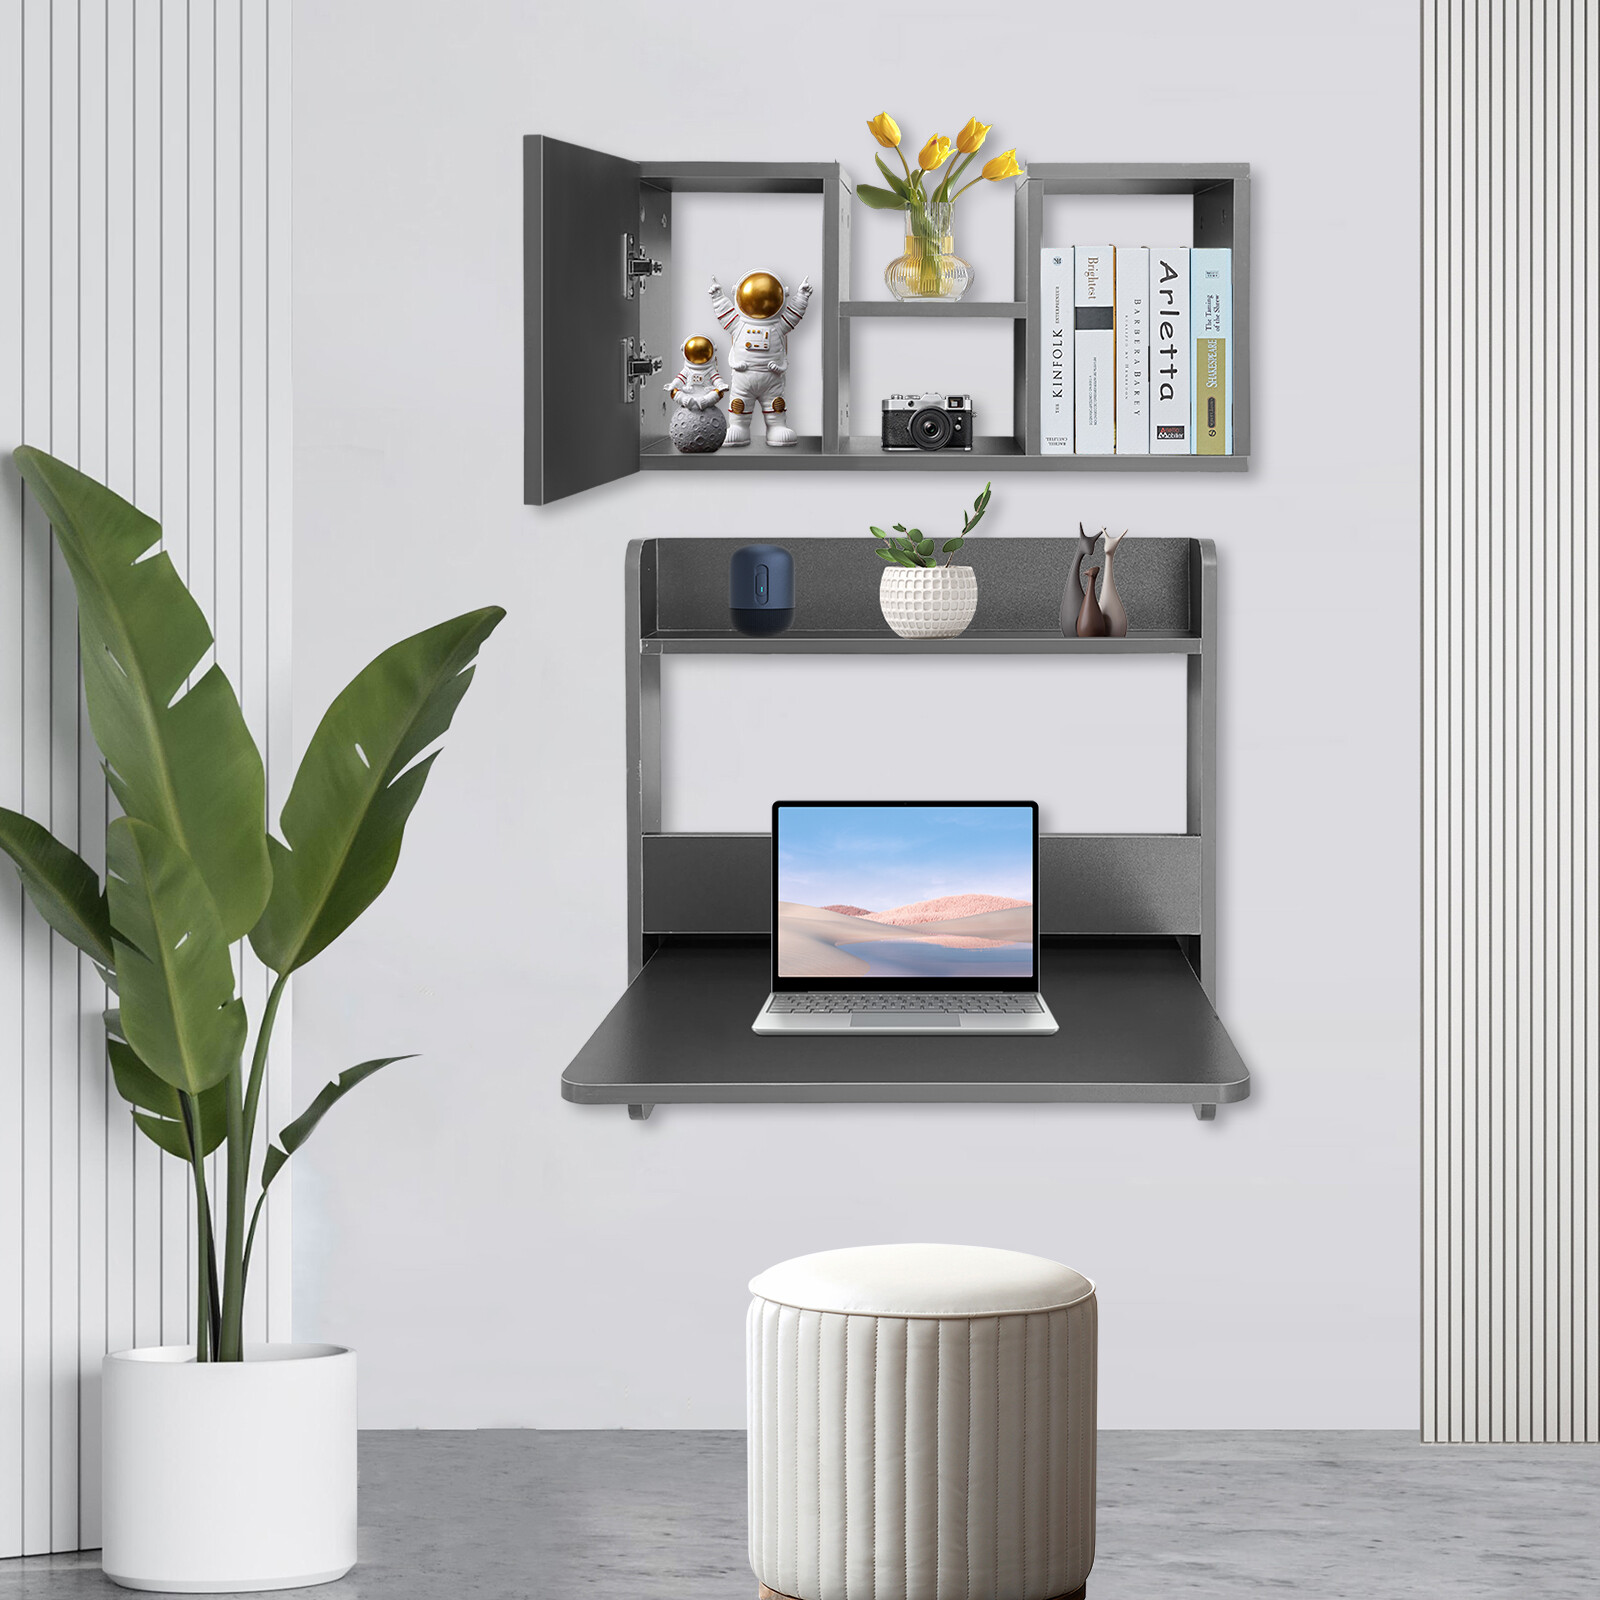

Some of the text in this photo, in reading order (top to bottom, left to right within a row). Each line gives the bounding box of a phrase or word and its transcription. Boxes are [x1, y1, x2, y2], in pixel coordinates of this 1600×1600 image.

[1084, 256, 1100, 300] Brightest
[1159, 260, 1180, 401] Arletta
[1205, 295, 1214, 317] Taming
[1052, 329, 1063, 398] KINFOLK
[1205, 339, 1218, 388] SHAKESPEARE
